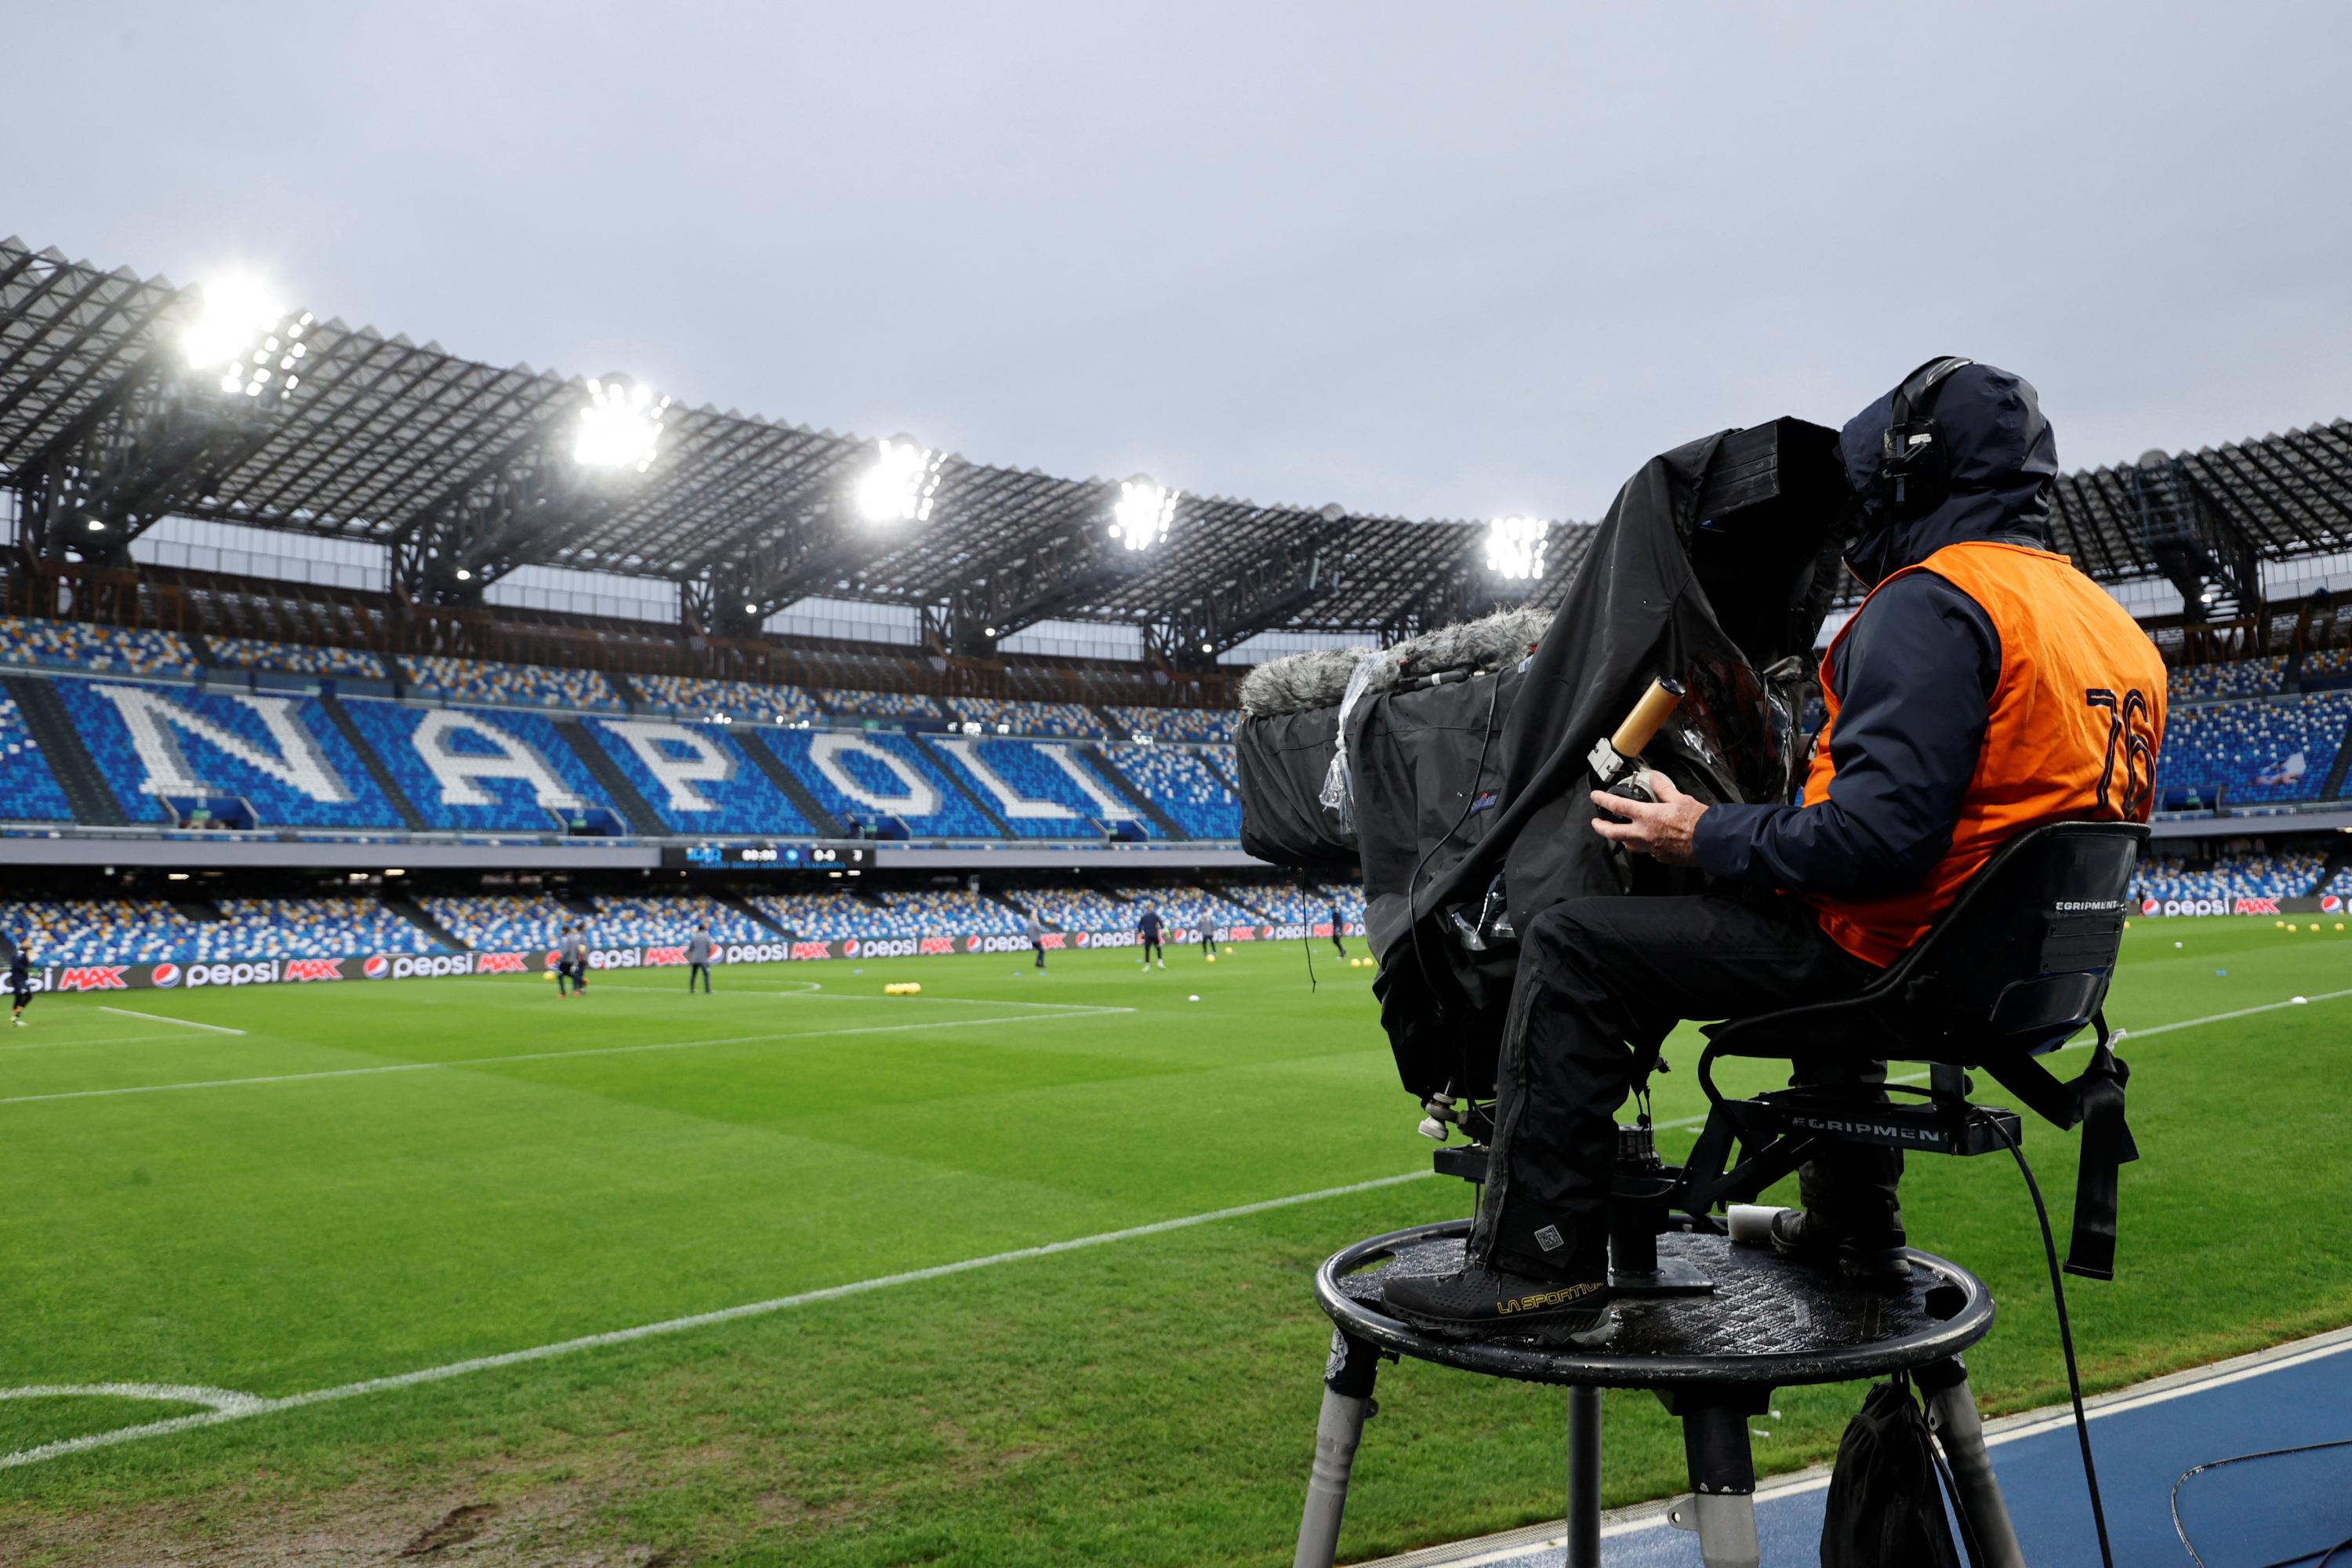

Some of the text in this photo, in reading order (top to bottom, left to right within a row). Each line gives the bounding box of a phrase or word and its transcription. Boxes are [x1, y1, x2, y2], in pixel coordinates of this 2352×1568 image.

[89, 684, 1142, 820] NAPOLI
[2086, 688, 2156, 817] 76
[742, 849, 777, 862] 00:00
[814, 849, 836, 862] 0-0
[2056, 900, 2118, 910] EGRIPMENT
[2165, 897, 2281, 917] pepsi MAX
[862, 937, 955, 958] pepsi MAX
[1091, 929, 1135, 948] pepsi
[588, 946, 690, 970] epsi MAX
[726, 941, 832, 964] pepsi MAX
[186, 958, 345, 989] pepsi MAX
[393, 952, 529, 979] pepsi MAX
[58, 965, 130, 991] MAX
[1497, 1299, 1521, 1314] LA
